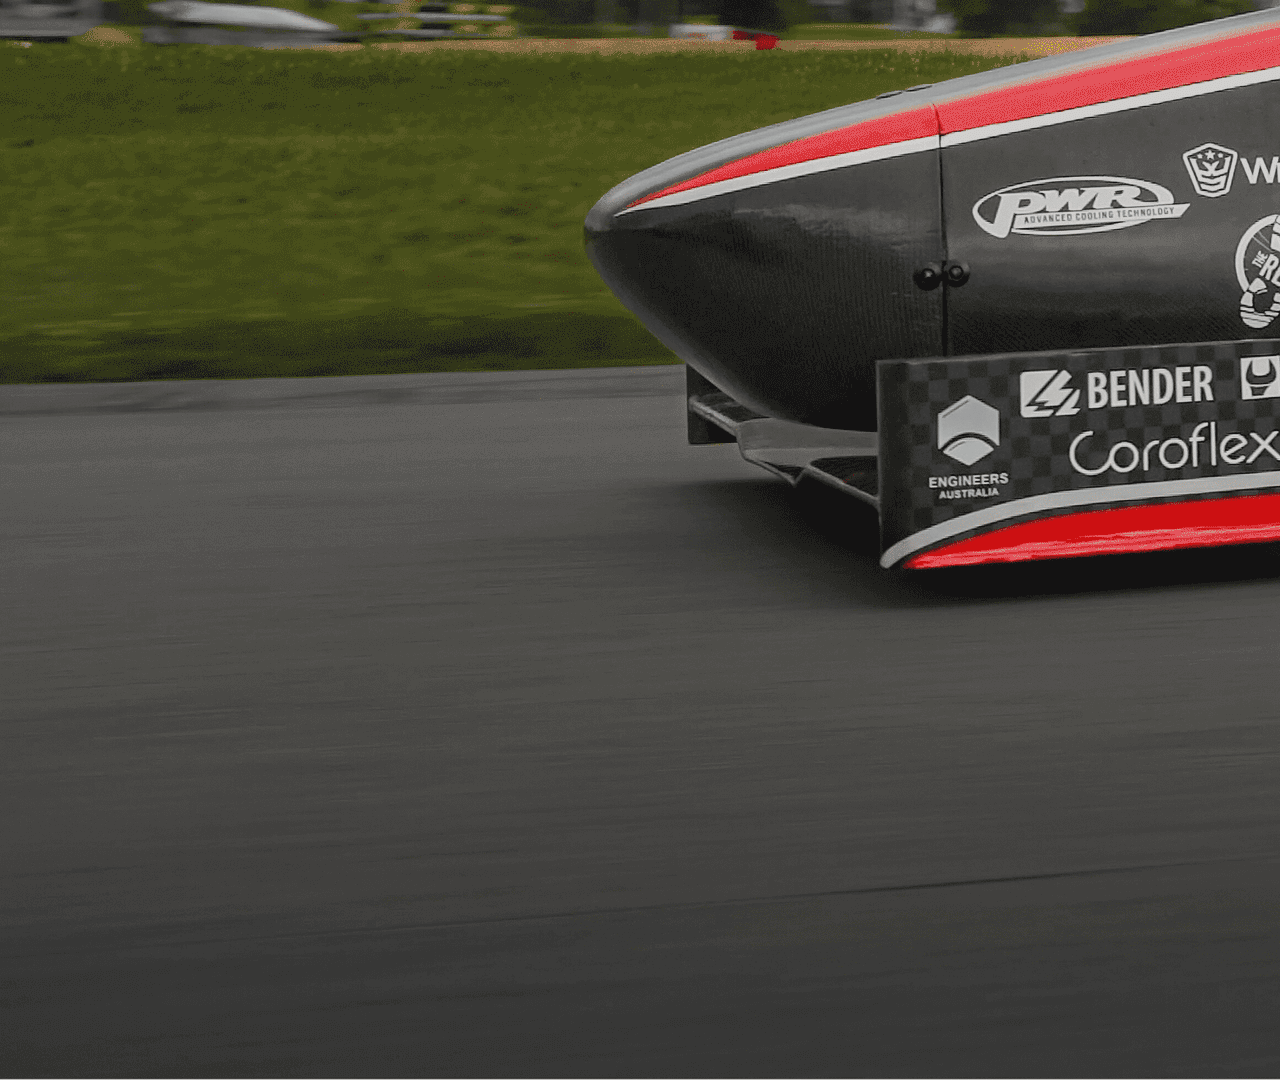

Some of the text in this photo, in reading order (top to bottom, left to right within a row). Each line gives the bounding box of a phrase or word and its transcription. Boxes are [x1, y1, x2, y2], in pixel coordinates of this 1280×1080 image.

[993, 185, 1158, 238] PWR
[1024, 206, 1175, 224] ADVANCED COOLING TECHNOLOGY
[1252, 250, 1268, 268] THE
[1087, 365, 1214, 409] BENDER
[929, 472, 1009, 488] ENGINEERS
[939, 488, 999, 500] AUSTRALIA
